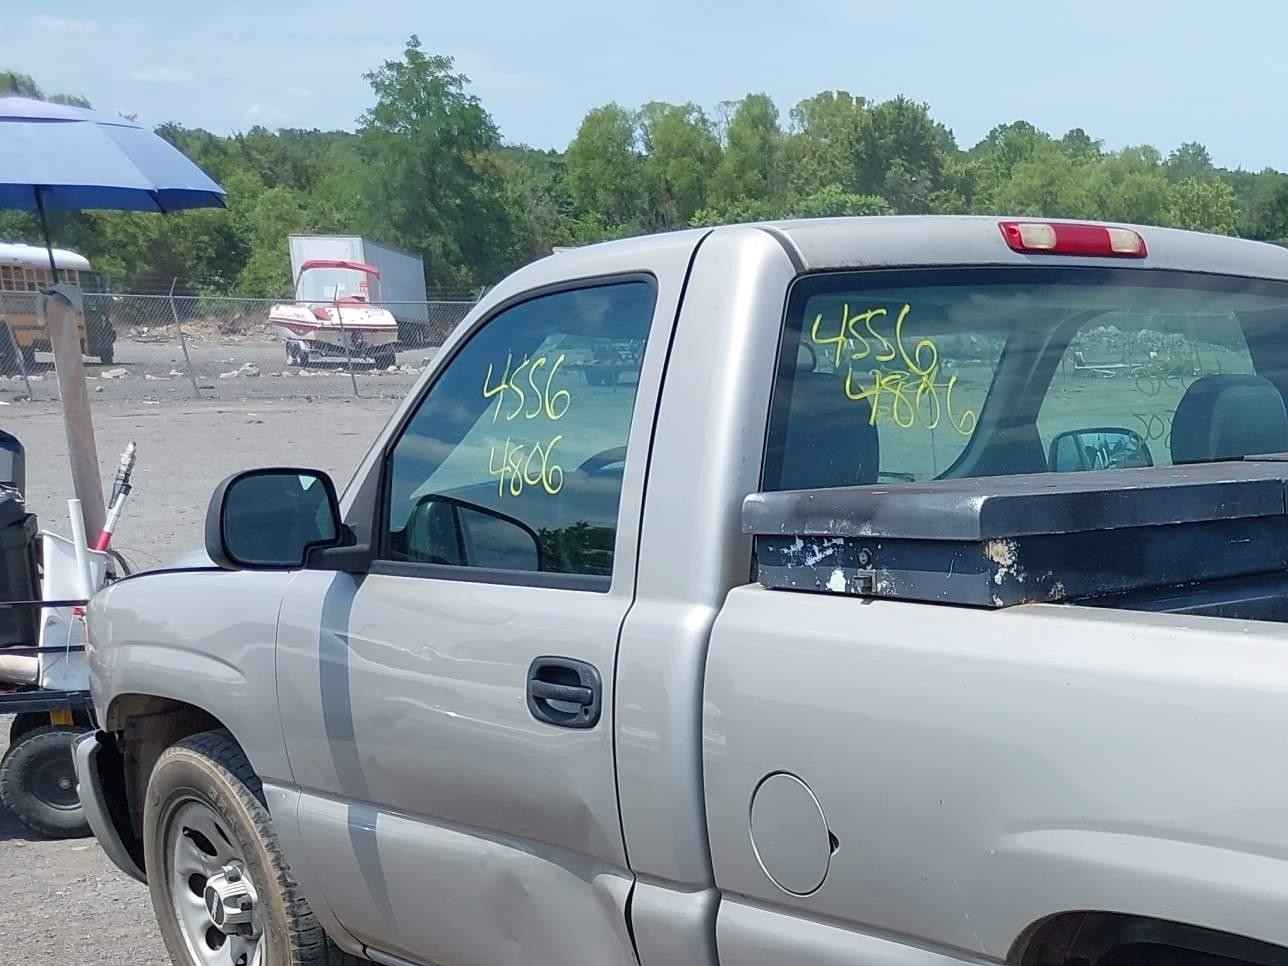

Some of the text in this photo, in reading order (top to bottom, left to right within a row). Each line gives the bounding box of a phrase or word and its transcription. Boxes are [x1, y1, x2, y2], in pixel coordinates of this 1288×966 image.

[811, 303, 938, 376] 4556
[483, 348, 571, 423] 4556
[488, 435, 564, 497] 4806
